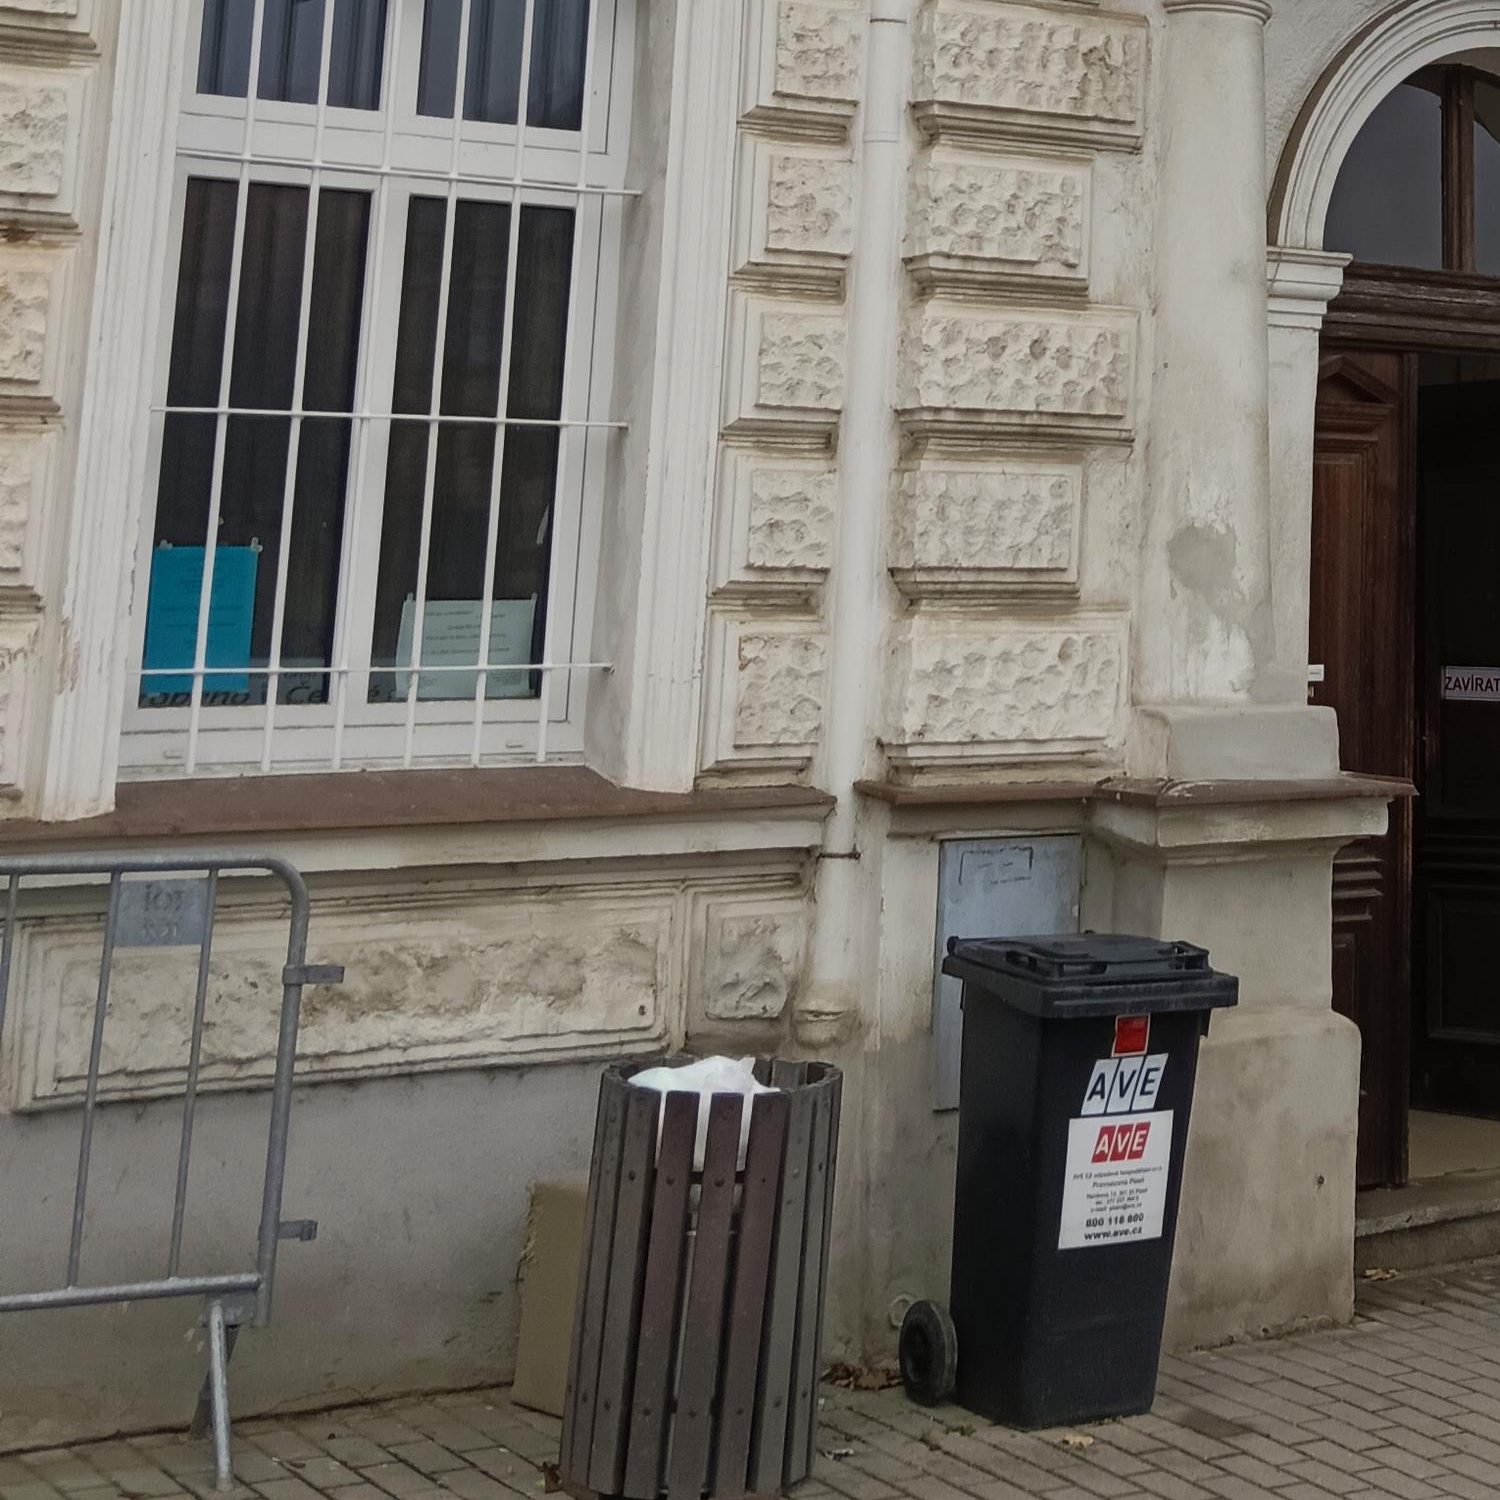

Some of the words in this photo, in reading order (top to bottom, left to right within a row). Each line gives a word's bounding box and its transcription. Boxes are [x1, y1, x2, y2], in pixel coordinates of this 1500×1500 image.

[1087, 1066, 1161, 1102] AVE
[1095, 1129, 1148, 1155] AVE
[1084, 1226, 1143, 1240] www.ave.cz
